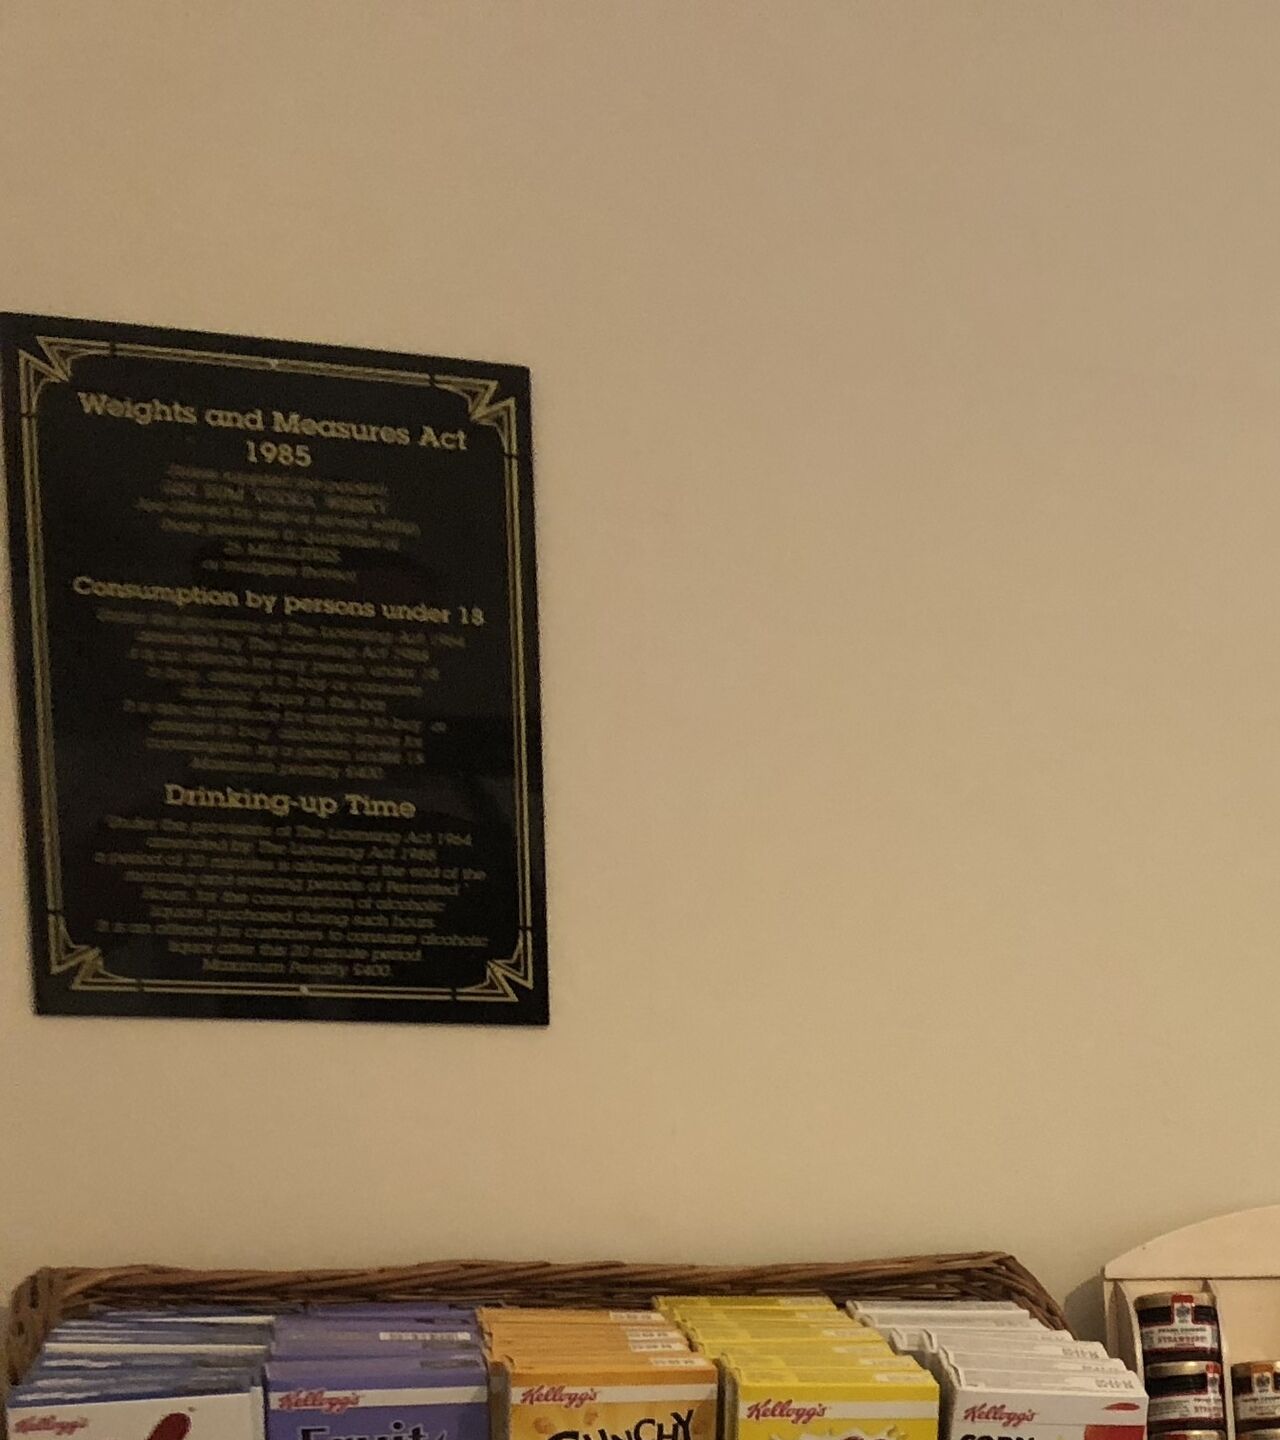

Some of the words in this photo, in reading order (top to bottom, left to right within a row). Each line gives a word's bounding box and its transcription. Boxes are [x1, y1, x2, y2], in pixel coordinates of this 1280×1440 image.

[77, 391, 197, 425] Weights
[205, 408, 263, 433] and
[272, 410, 409, 446] Measures
[419, 427, 468, 451] Act
[246, 441, 312, 468] 1985
[72, 575, 239, 612] Consumption
[246, 589, 279, 616] by
[284, 596, 376, 621] persons
[381, 602, 451, 625] under
[458, 605, 485, 627] 18
[164, 782, 339, 821] Drinking-up
[342, 793, 416, 819] Time
[279, 1387, 360, 1415] Kellogg's
[520, 1385, 599, 1409] Kellogg's
[746, 1398, 828, 1425] Kellogg's
[963, 1402, 1037, 1427] Kellogg's
